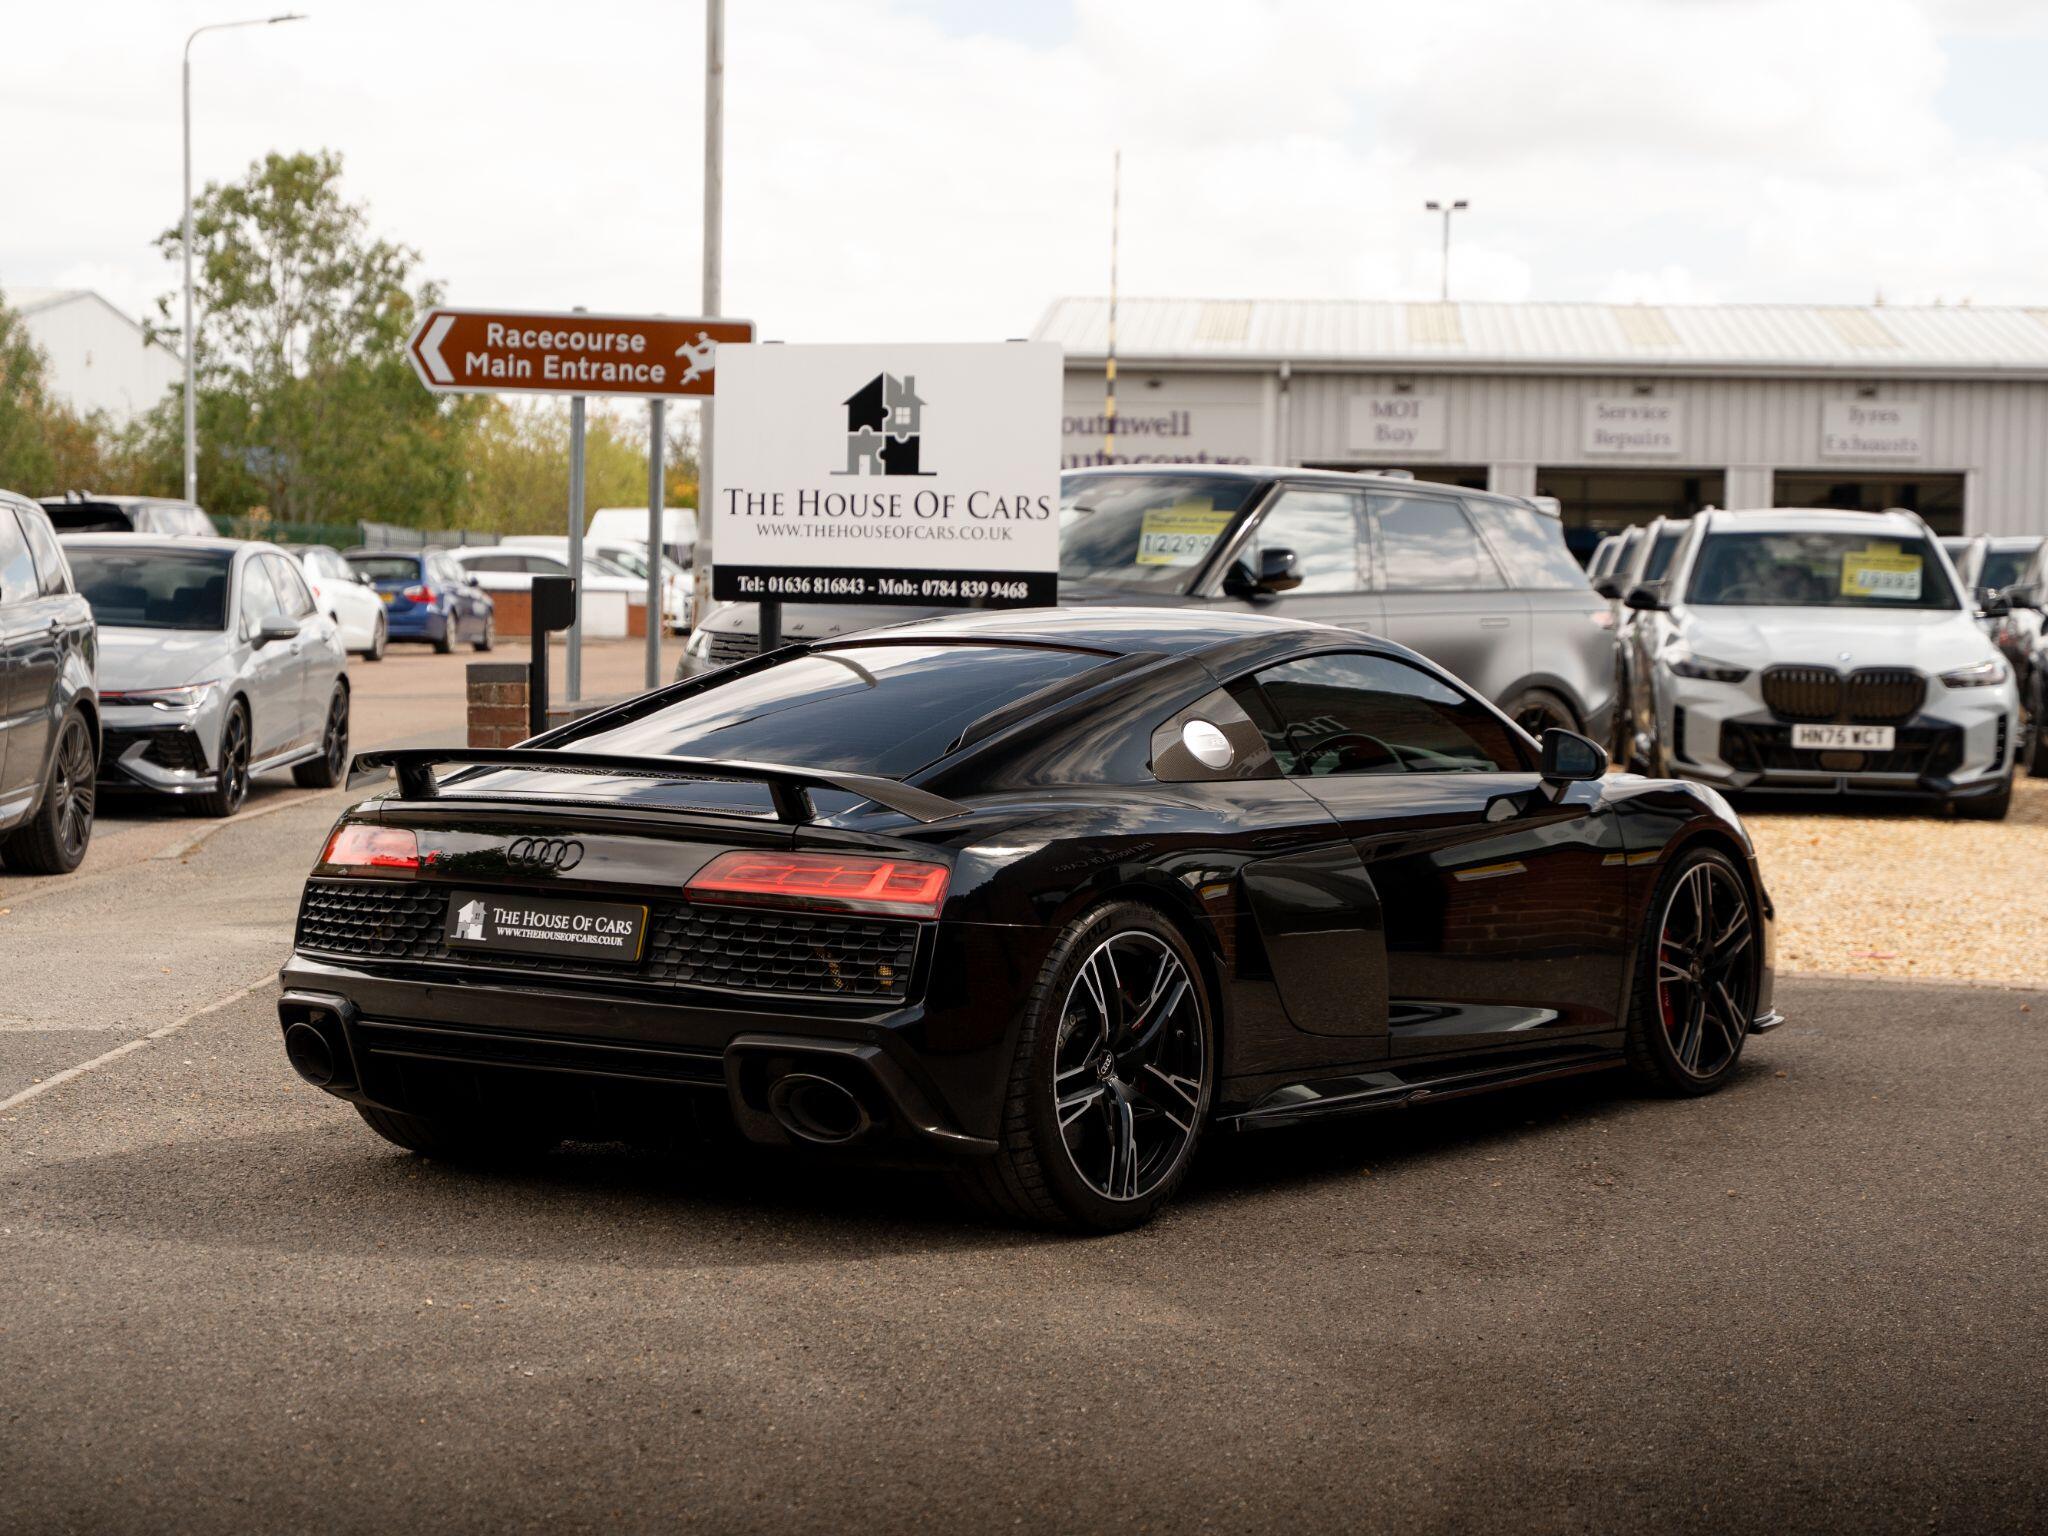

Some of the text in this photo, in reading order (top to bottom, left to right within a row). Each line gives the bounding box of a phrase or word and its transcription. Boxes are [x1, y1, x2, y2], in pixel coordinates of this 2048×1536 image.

[487, 322, 647, 351] Racecourse
[465, 351, 667, 382] Main Entrance
[1062, 410, 1191, 437] outhwell
[756, 523, 1014, 541] WWW.THEHOUSEOFCARS.CO.UK
[737, 576, 765, 593] Tel:
[768, 577, 811, 593] 01636
[813, 578, 865, 594] 816843
[878, 579, 918, 597] Mob:
[921, 580, 957, 597] 0784
[960, 581, 988, 598] 839
[991, 582, 1028, 599] 9468
